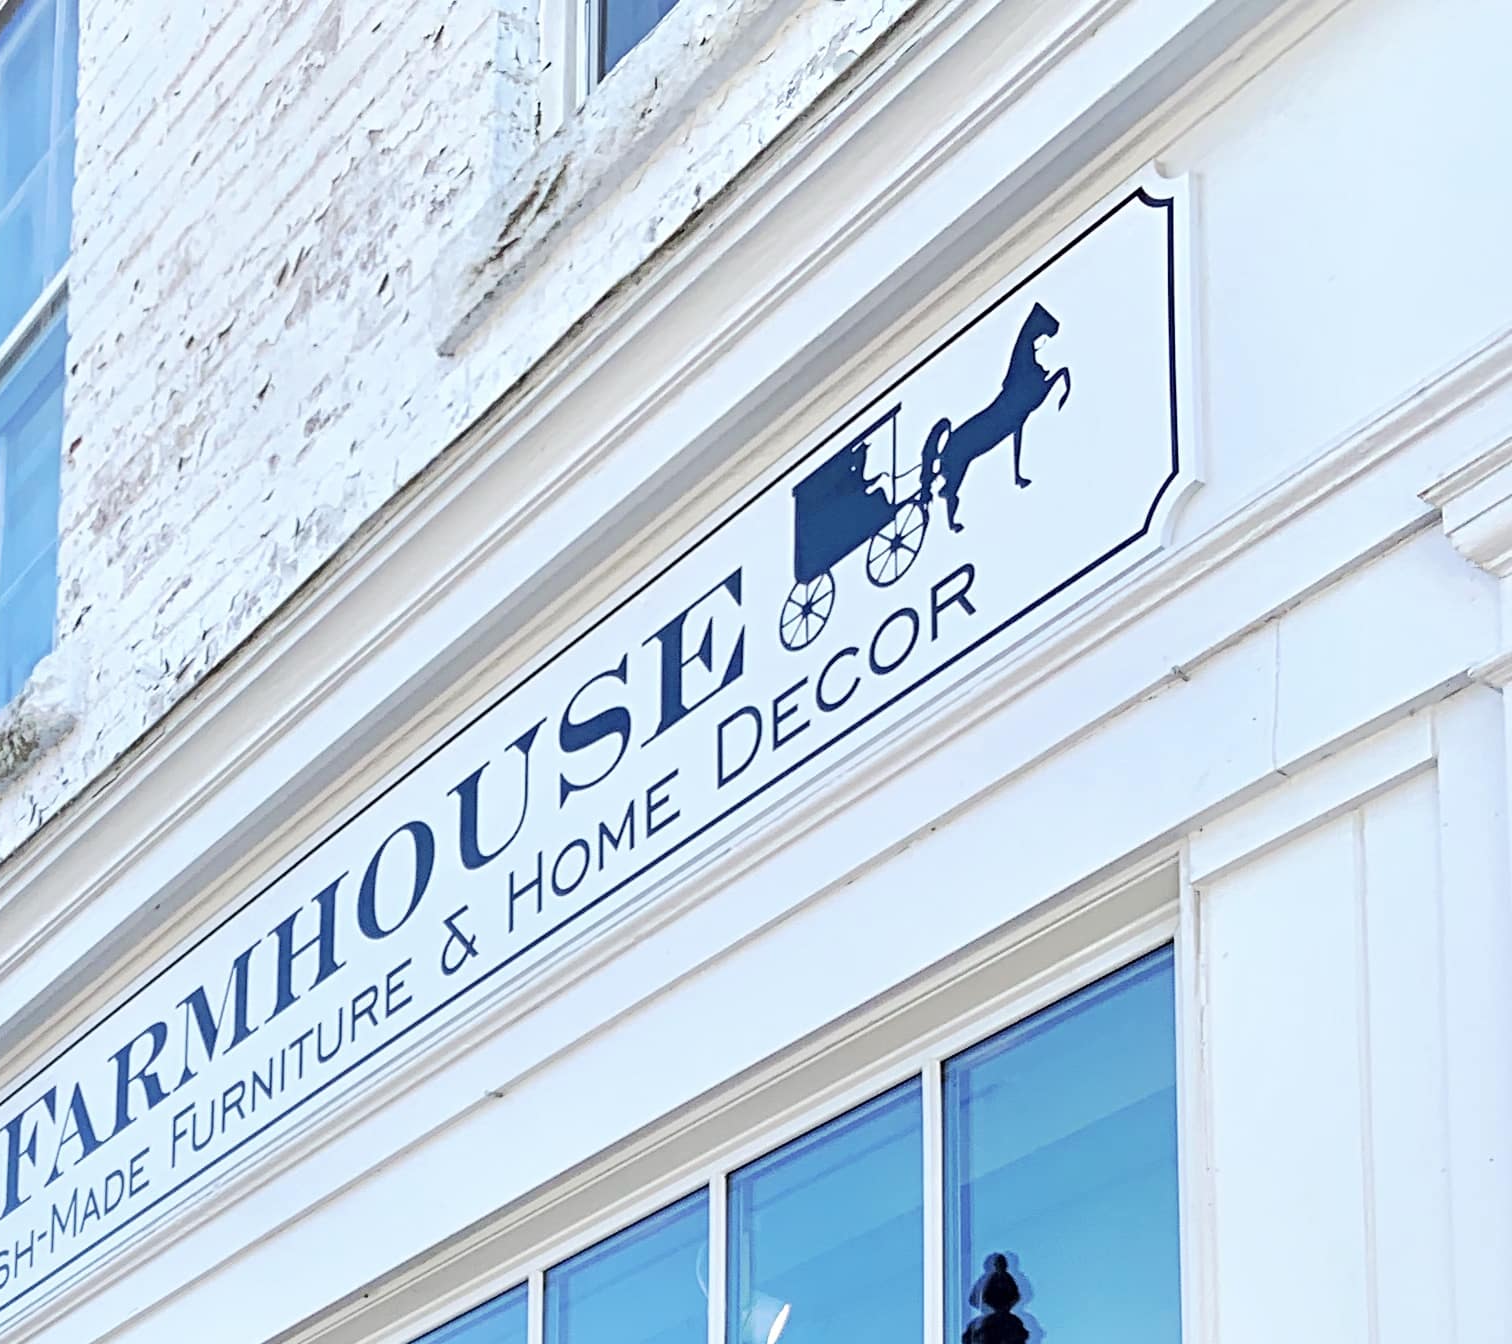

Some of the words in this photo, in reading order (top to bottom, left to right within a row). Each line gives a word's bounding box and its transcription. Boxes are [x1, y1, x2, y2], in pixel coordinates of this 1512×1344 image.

[171, 958, 413, 1168] FURNITURE
[440, 905, 479, 976] &
[507, 767, 682, 933] HOME
[716, 562, 977, 789] DECOR
